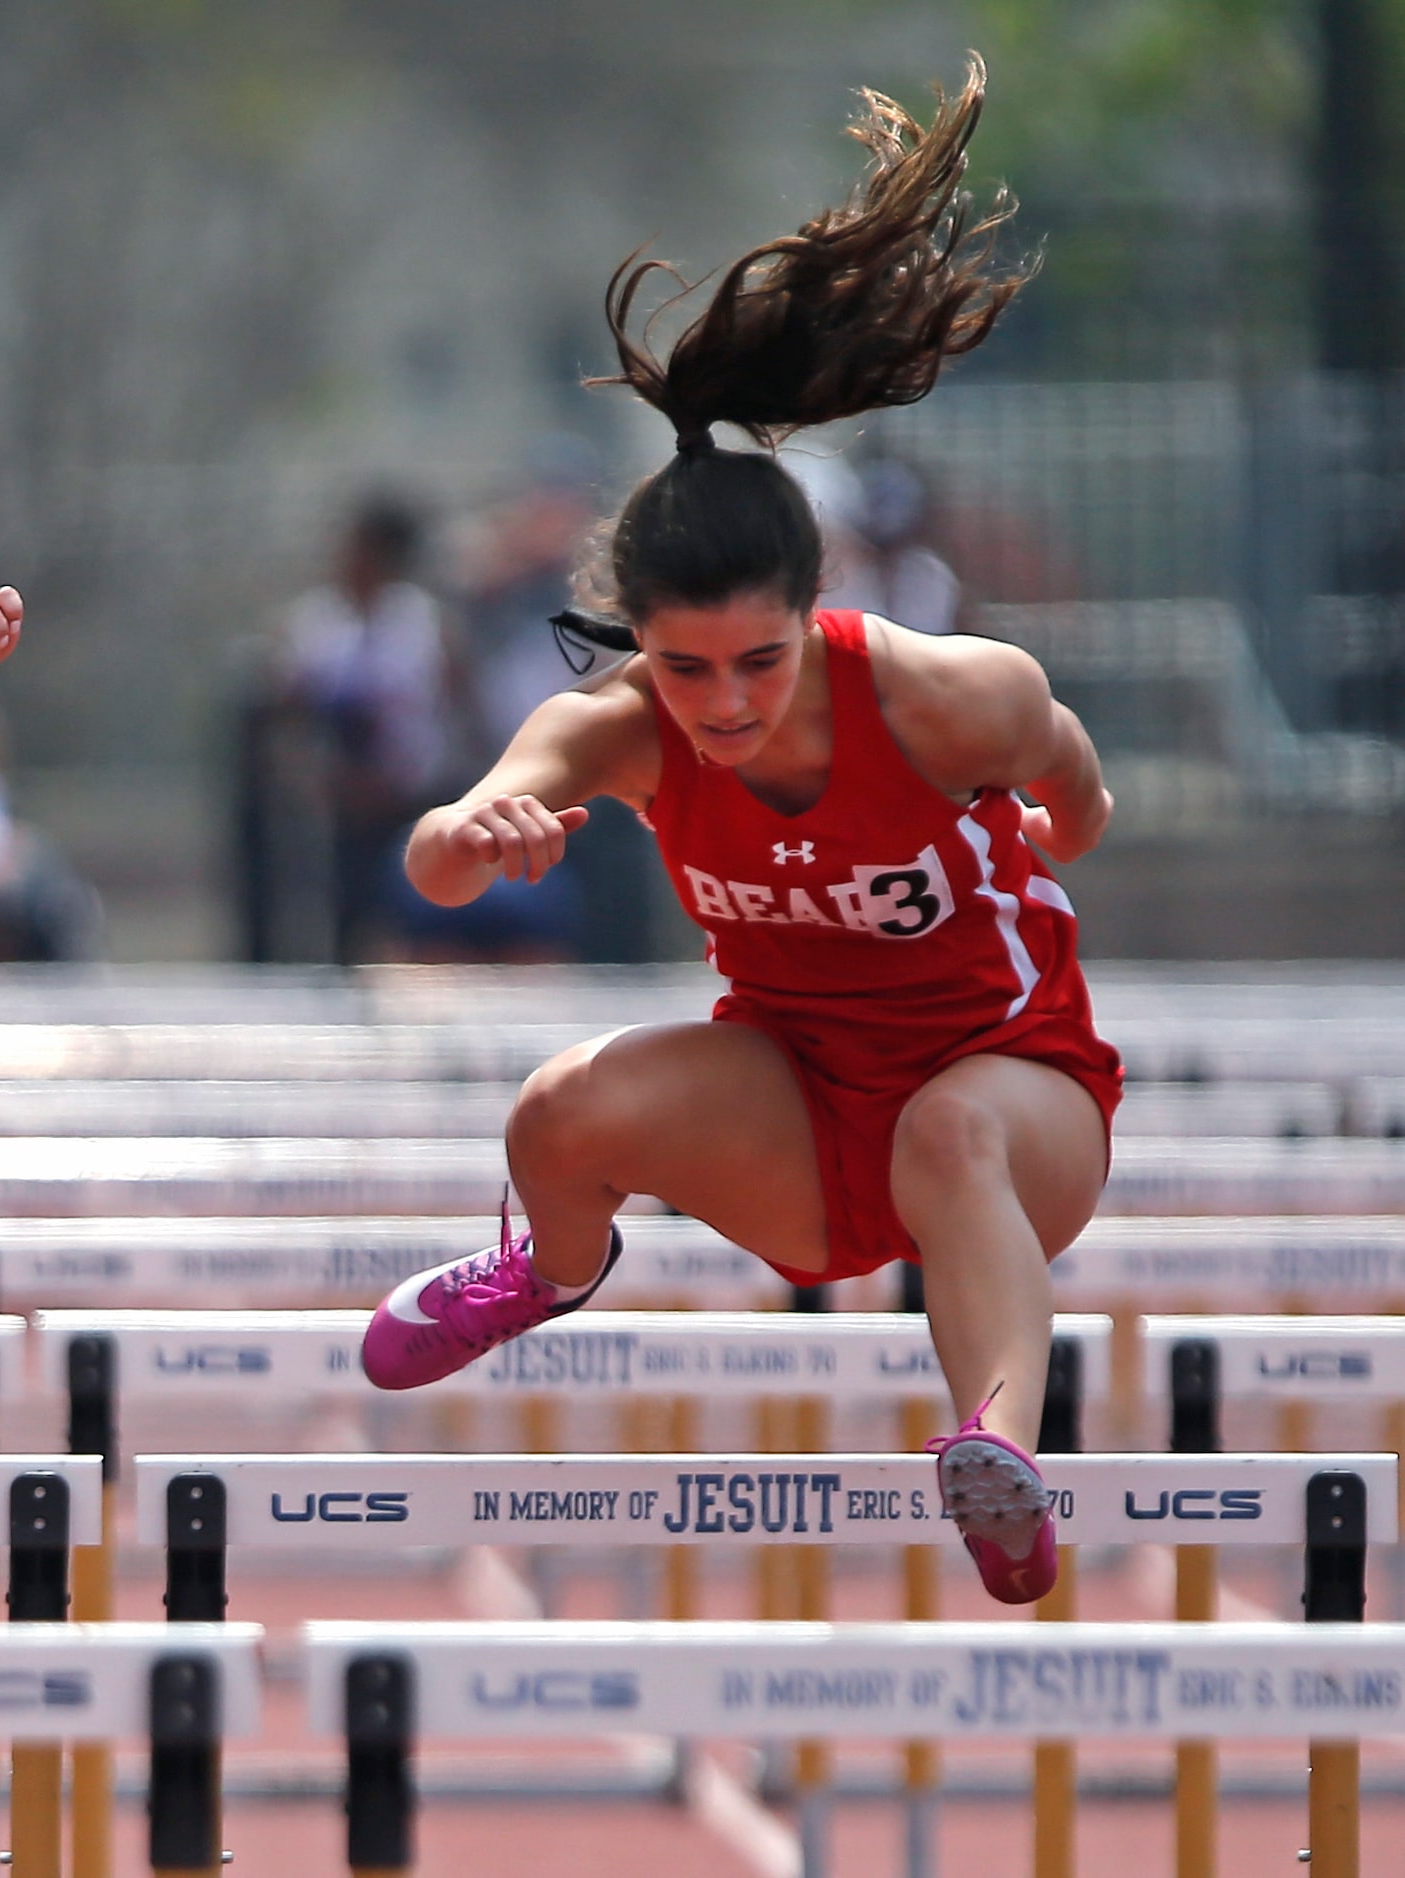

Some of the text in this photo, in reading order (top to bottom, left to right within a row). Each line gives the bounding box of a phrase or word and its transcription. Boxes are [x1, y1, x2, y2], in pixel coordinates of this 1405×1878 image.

[869, 868, 941, 936] 3
[489, 1332, 639, 1383] JESUIT
[271, 1492, 409, 1523] UCS
[474, 1491, 500, 1521] IN
[509, 1491, 620, 1521] MEMORY
[629, 1491, 659, 1521] OF
[664, 1473, 841, 1534] JESUIT
[846, 1490, 901, 1520] ERIC
[910, 1490, 930, 1520] S.
[1124, 1490, 1262, 1521] UCS
[953, 1649, 1171, 1725] JESUIT
